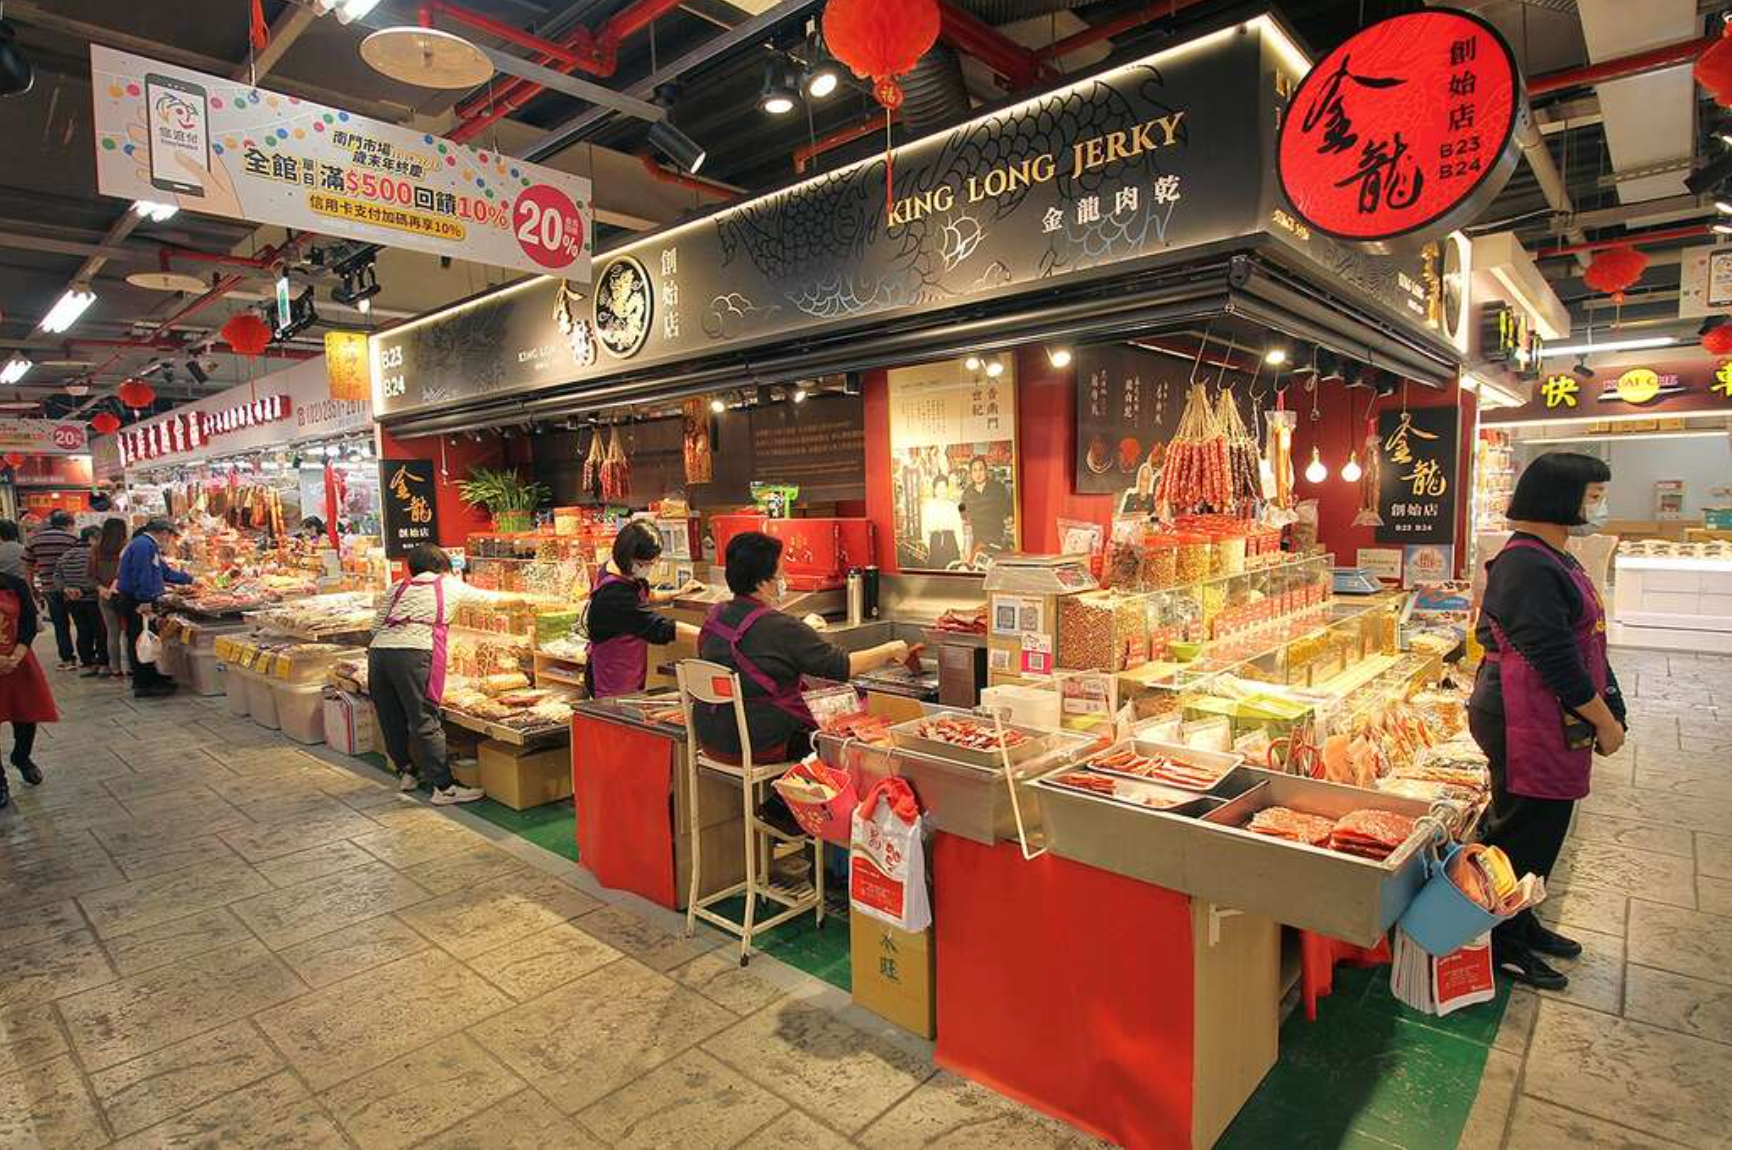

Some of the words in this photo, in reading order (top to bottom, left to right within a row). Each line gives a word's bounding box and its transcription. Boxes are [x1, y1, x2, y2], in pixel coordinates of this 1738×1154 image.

[1448, 35, 1477, 134] 創始店
[333, 130, 392, 153] 南門市場
[1301, 52, 1424, 214] 金龍
[1439, 135, 1481, 160] B23
[887, 186, 955, 228] KING
[967, 153, 1056, 204] LONG
[1071, 111, 1185, 180] JERKY
[1438, 157, 1482, 180] B24
[309, 194, 461, 238] 信用卡支付加碼再享10%
[518, 200, 579, 258] 20%
[1041, 174, 1181, 234] 金龍肉乾
[1541, 373, 1580, 408] 快
[1384, 414, 1448, 497] 金龍
